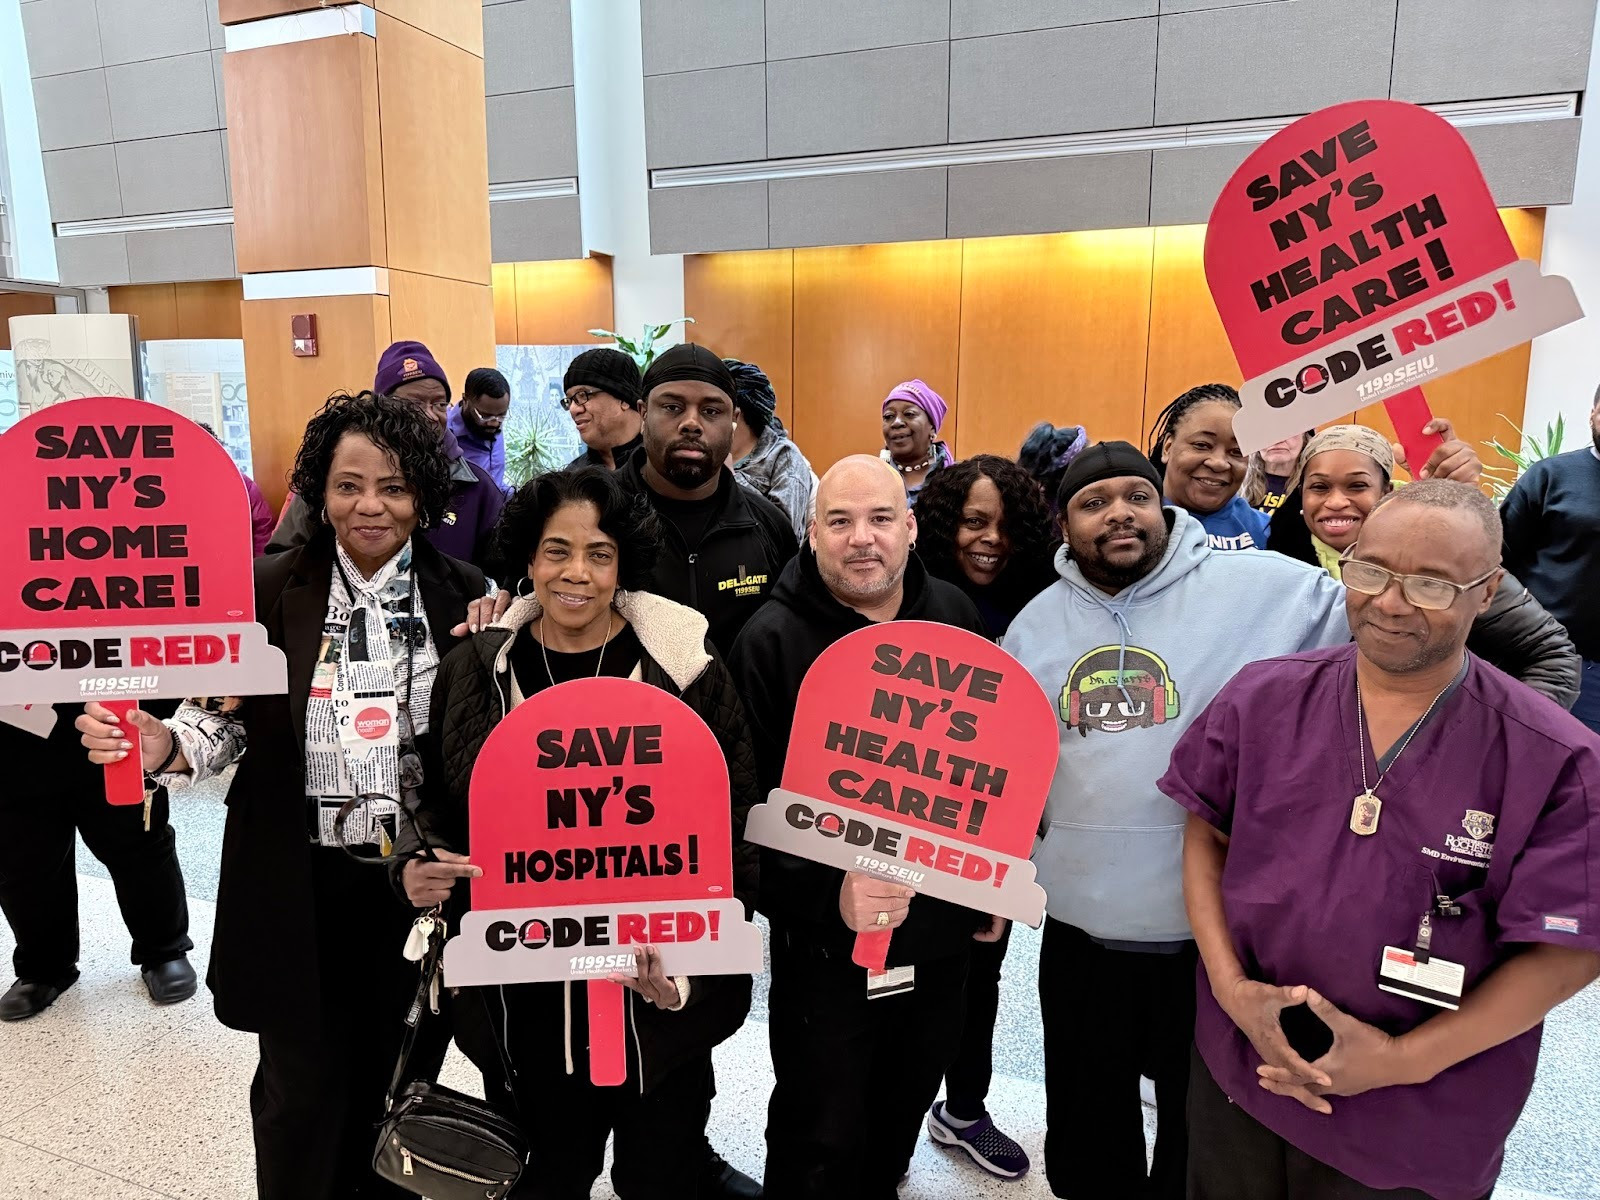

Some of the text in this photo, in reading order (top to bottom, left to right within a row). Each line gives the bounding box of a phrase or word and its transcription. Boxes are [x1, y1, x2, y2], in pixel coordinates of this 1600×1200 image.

[1247, 120, 1378, 212] SAVE
[1269, 172, 1384, 252] NY'S
[1250, 194, 1448, 312] HEALTH
[1281, 238, 1455, 345] CARE!
[1264, 278, 1516, 409] CODE RED!
[1356, 354, 1435, 397] 1199SEIU
[35, 425, 175, 459] SAVE
[47, 468, 166, 509] NY'S
[29, 525, 189, 561] HOME
[21, 566, 201, 612] CARE!
[130, 634, 241, 667] RED!
[871, 644, 1004, 703] SAVE
[79, 676, 159, 691] 1199SEIU
[357, 719, 390, 727] woman
[870, 689, 978, 742] NY'S
[536, 725, 663, 769] SAVE
[824, 721, 1009, 798] HEALTH
[546, 777, 655, 829] NY'S
[828, 769, 988, 836] CARE!
[504, 835, 699, 884] HOSPITALS!
[785, 803, 1010, 888] CODE RED!
[855, 855, 925, 883] 1199SEIU
[1421, 847, 1440, 858] SMD
[485, 911, 721, 952] CODE RED!
